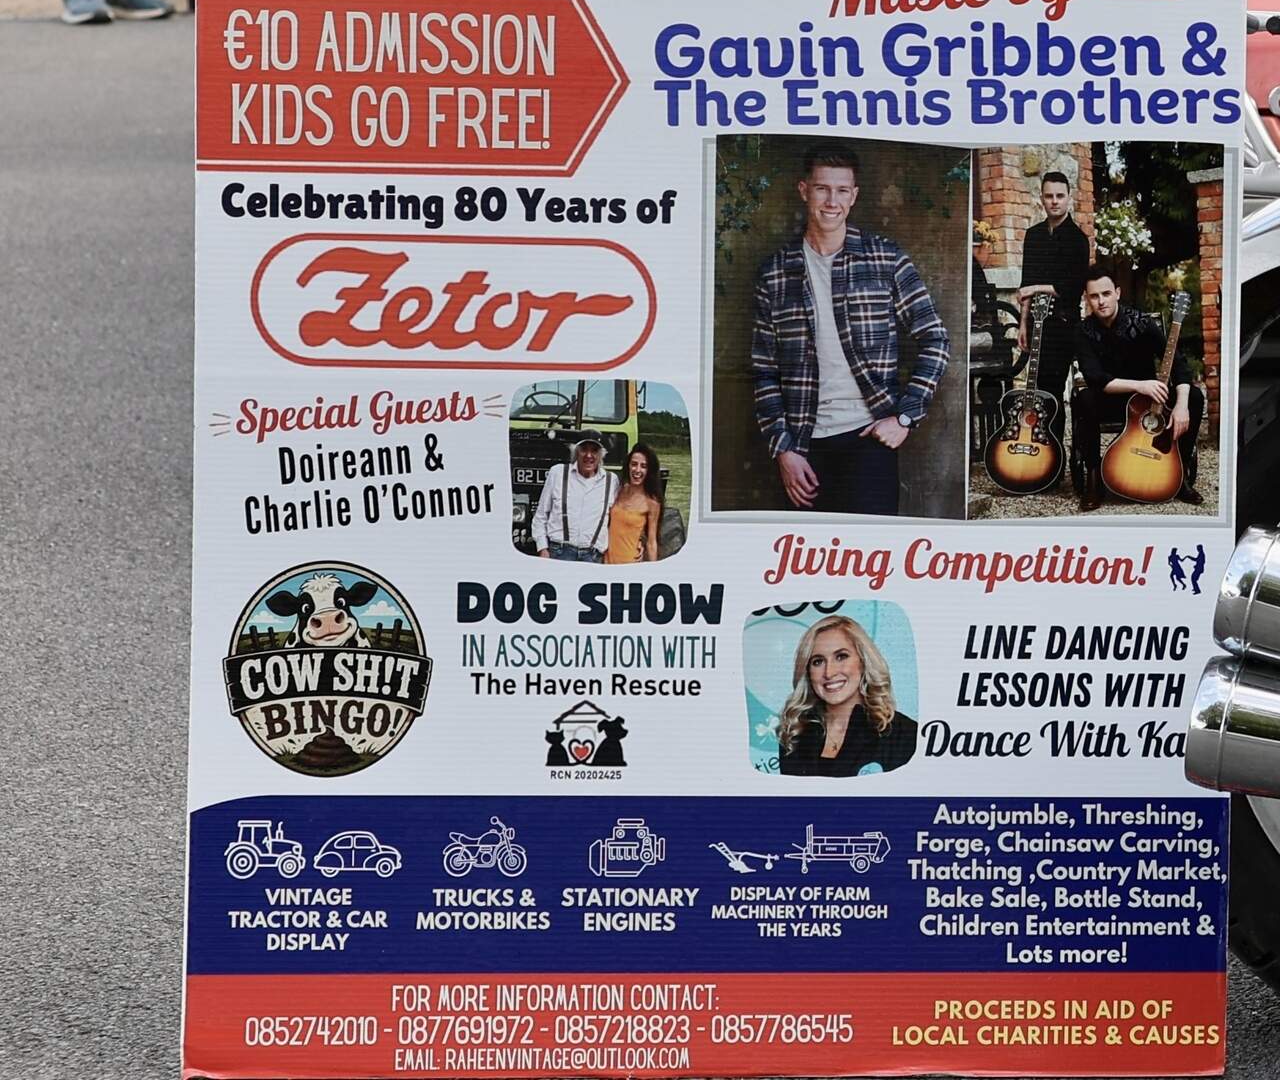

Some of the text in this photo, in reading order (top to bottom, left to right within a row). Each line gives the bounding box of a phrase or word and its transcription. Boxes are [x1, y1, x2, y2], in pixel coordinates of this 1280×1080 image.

[223, 9, 555, 76] €10 ADMISSION
[654, 22, 1227, 78] Gavin Gribben &
[654, 77, 1241, 127] The Ennis Brothers
[231, 83, 551, 150] KIDS GO FREE!
[221, 183, 678, 228] Celebrating 80 Years of
[296, 246, 634, 352] Zetor
[236, 390, 481, 444] Special Guests
[278, 433, 444, 485] Doireann &
[246, 490, 351, 534] Charlie
[764, 533, 1155, 592] Jiving Competition!
[456, 581, 557, 624] DOG
[577, 582, 724, 625] SHOW
[461, 634, 717, 670] IN ASSOCIATION WITH
[964, 625, 1190, 661] LINE DANCING
[240, 652, 420, 699] COW SH!T
[470, 673, 702, 696] The Haven Rescue
[956, 673, 1186, 708] LESSONS WITH
[260, 699, 404, 741] BINGO!
[921, 719, 1186, 758] Dance With Ka
[550, 769, 622, 780] RCN 20202425
[933, 804, 1203, 829] Autojumble, Threshing,
[916, 832, 1220, 856] Forge, Chainsaw Carving,
[907, 861, 1022, 885] Thatching
[1137, 862, 1228, 884] Market,
[265, 888, 352, 906] VINTAGE
[432, 889, 537, 907] TRUCKS &
[561, 888, 699, 907] STATIONARY
[730, 886, 870, 902] DISPLAY OF FARM
[926, 888, 1203, 912] Bake Sale, Bottle Stand,
[228, 911, 388, 929] TRACTOR & CAR
[415, 912, 550, 930] MOTORBIKES
[583, 912, 676, 932] ENGINES
[711, 904, 888, 919] MACHINERY THROUGH
[757, 922, 842, 937] THE YEARS
[919, 915, 1215, 936] Children Entertainment &
[266, 933, 349, 951] DISPLAY
[1006, 943, 1128, 964] Lots more!
[391, 984, 720, 1013] FOR MORE INFORMATION CONTACT:
[933, 1000, 1173, 1021] PROCEEDS IN AID OF
[244, 1016, 378, 1046] 0852742010
[398, 1015, 534, 1046] 0877691972
[554, 1015, 691, 1045] 0857218823
[711, 1014, 853, 1044] 0857786545
[892, 1026, 1220, 1046] LOCAL CHARITIES & CAUSES
[394, 1047, 690, 1071] EMAIL: RAHEENVINTAGE@OUTLOOK.COM
